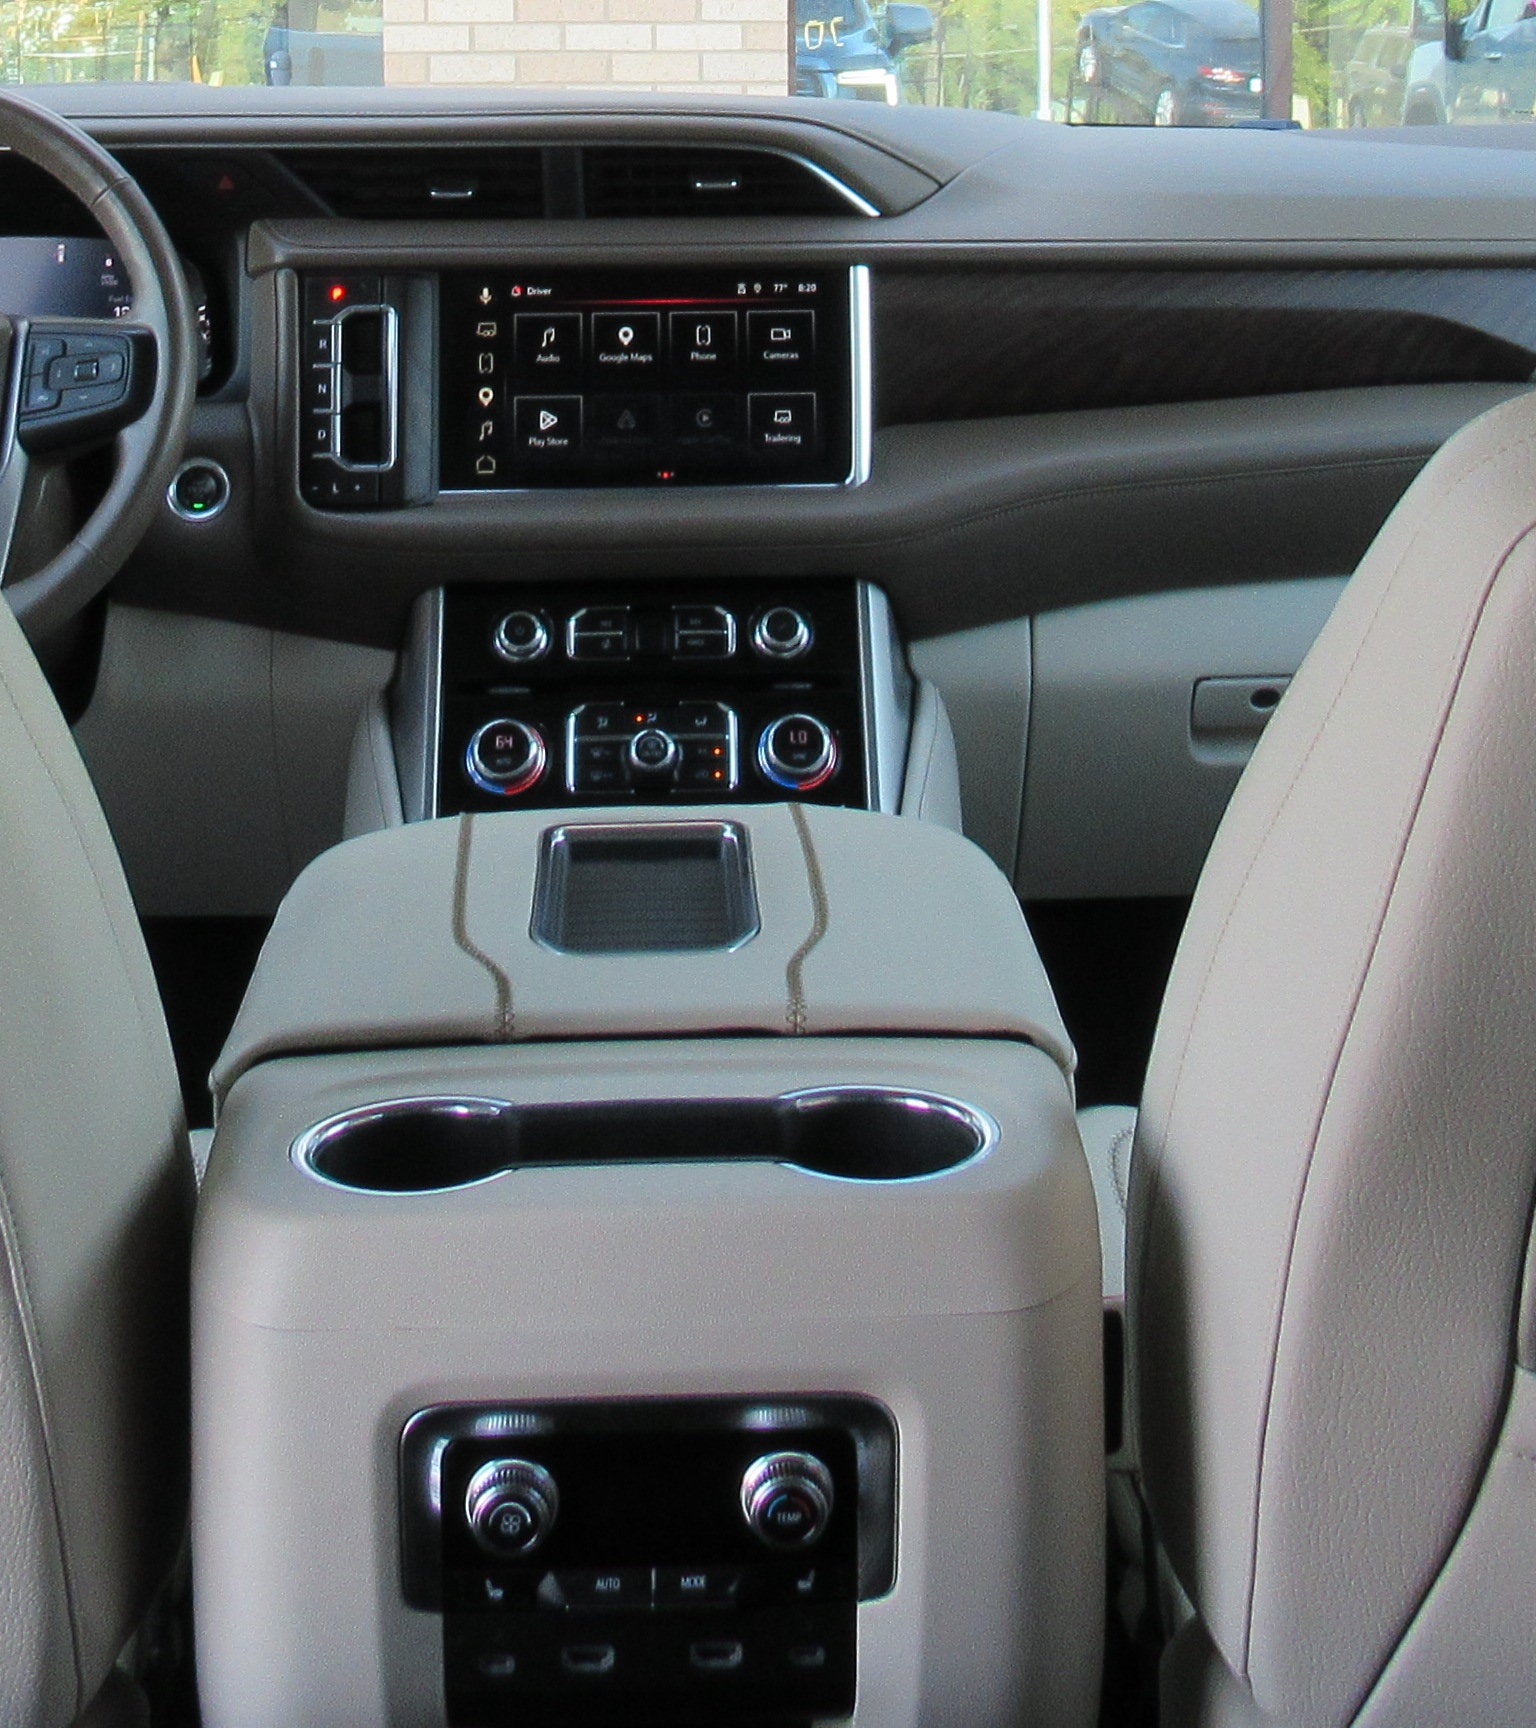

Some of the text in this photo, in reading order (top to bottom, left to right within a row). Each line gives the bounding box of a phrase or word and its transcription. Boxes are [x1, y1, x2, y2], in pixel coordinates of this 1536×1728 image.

[526, 286, 552, 296] Driver
[319, 339, 328, 349] R
[536, 353, 560, 363] Audio
[599, 353, 653, 364] Google Maps
[690, 351, 717, 361] Phone
[763, 350, 799, 360] Cameras
[318, 384, 327, 394] N
[318, 429, 327, 440] D
[764, 433, 802, 445] Trailering
[529, 436, 569, 448] Play Store
[777, 1511, 802, 1522] TEMP
[595, 1576, 621, 1590] AUTO
[680, 1575, 706, 1589] MODE
